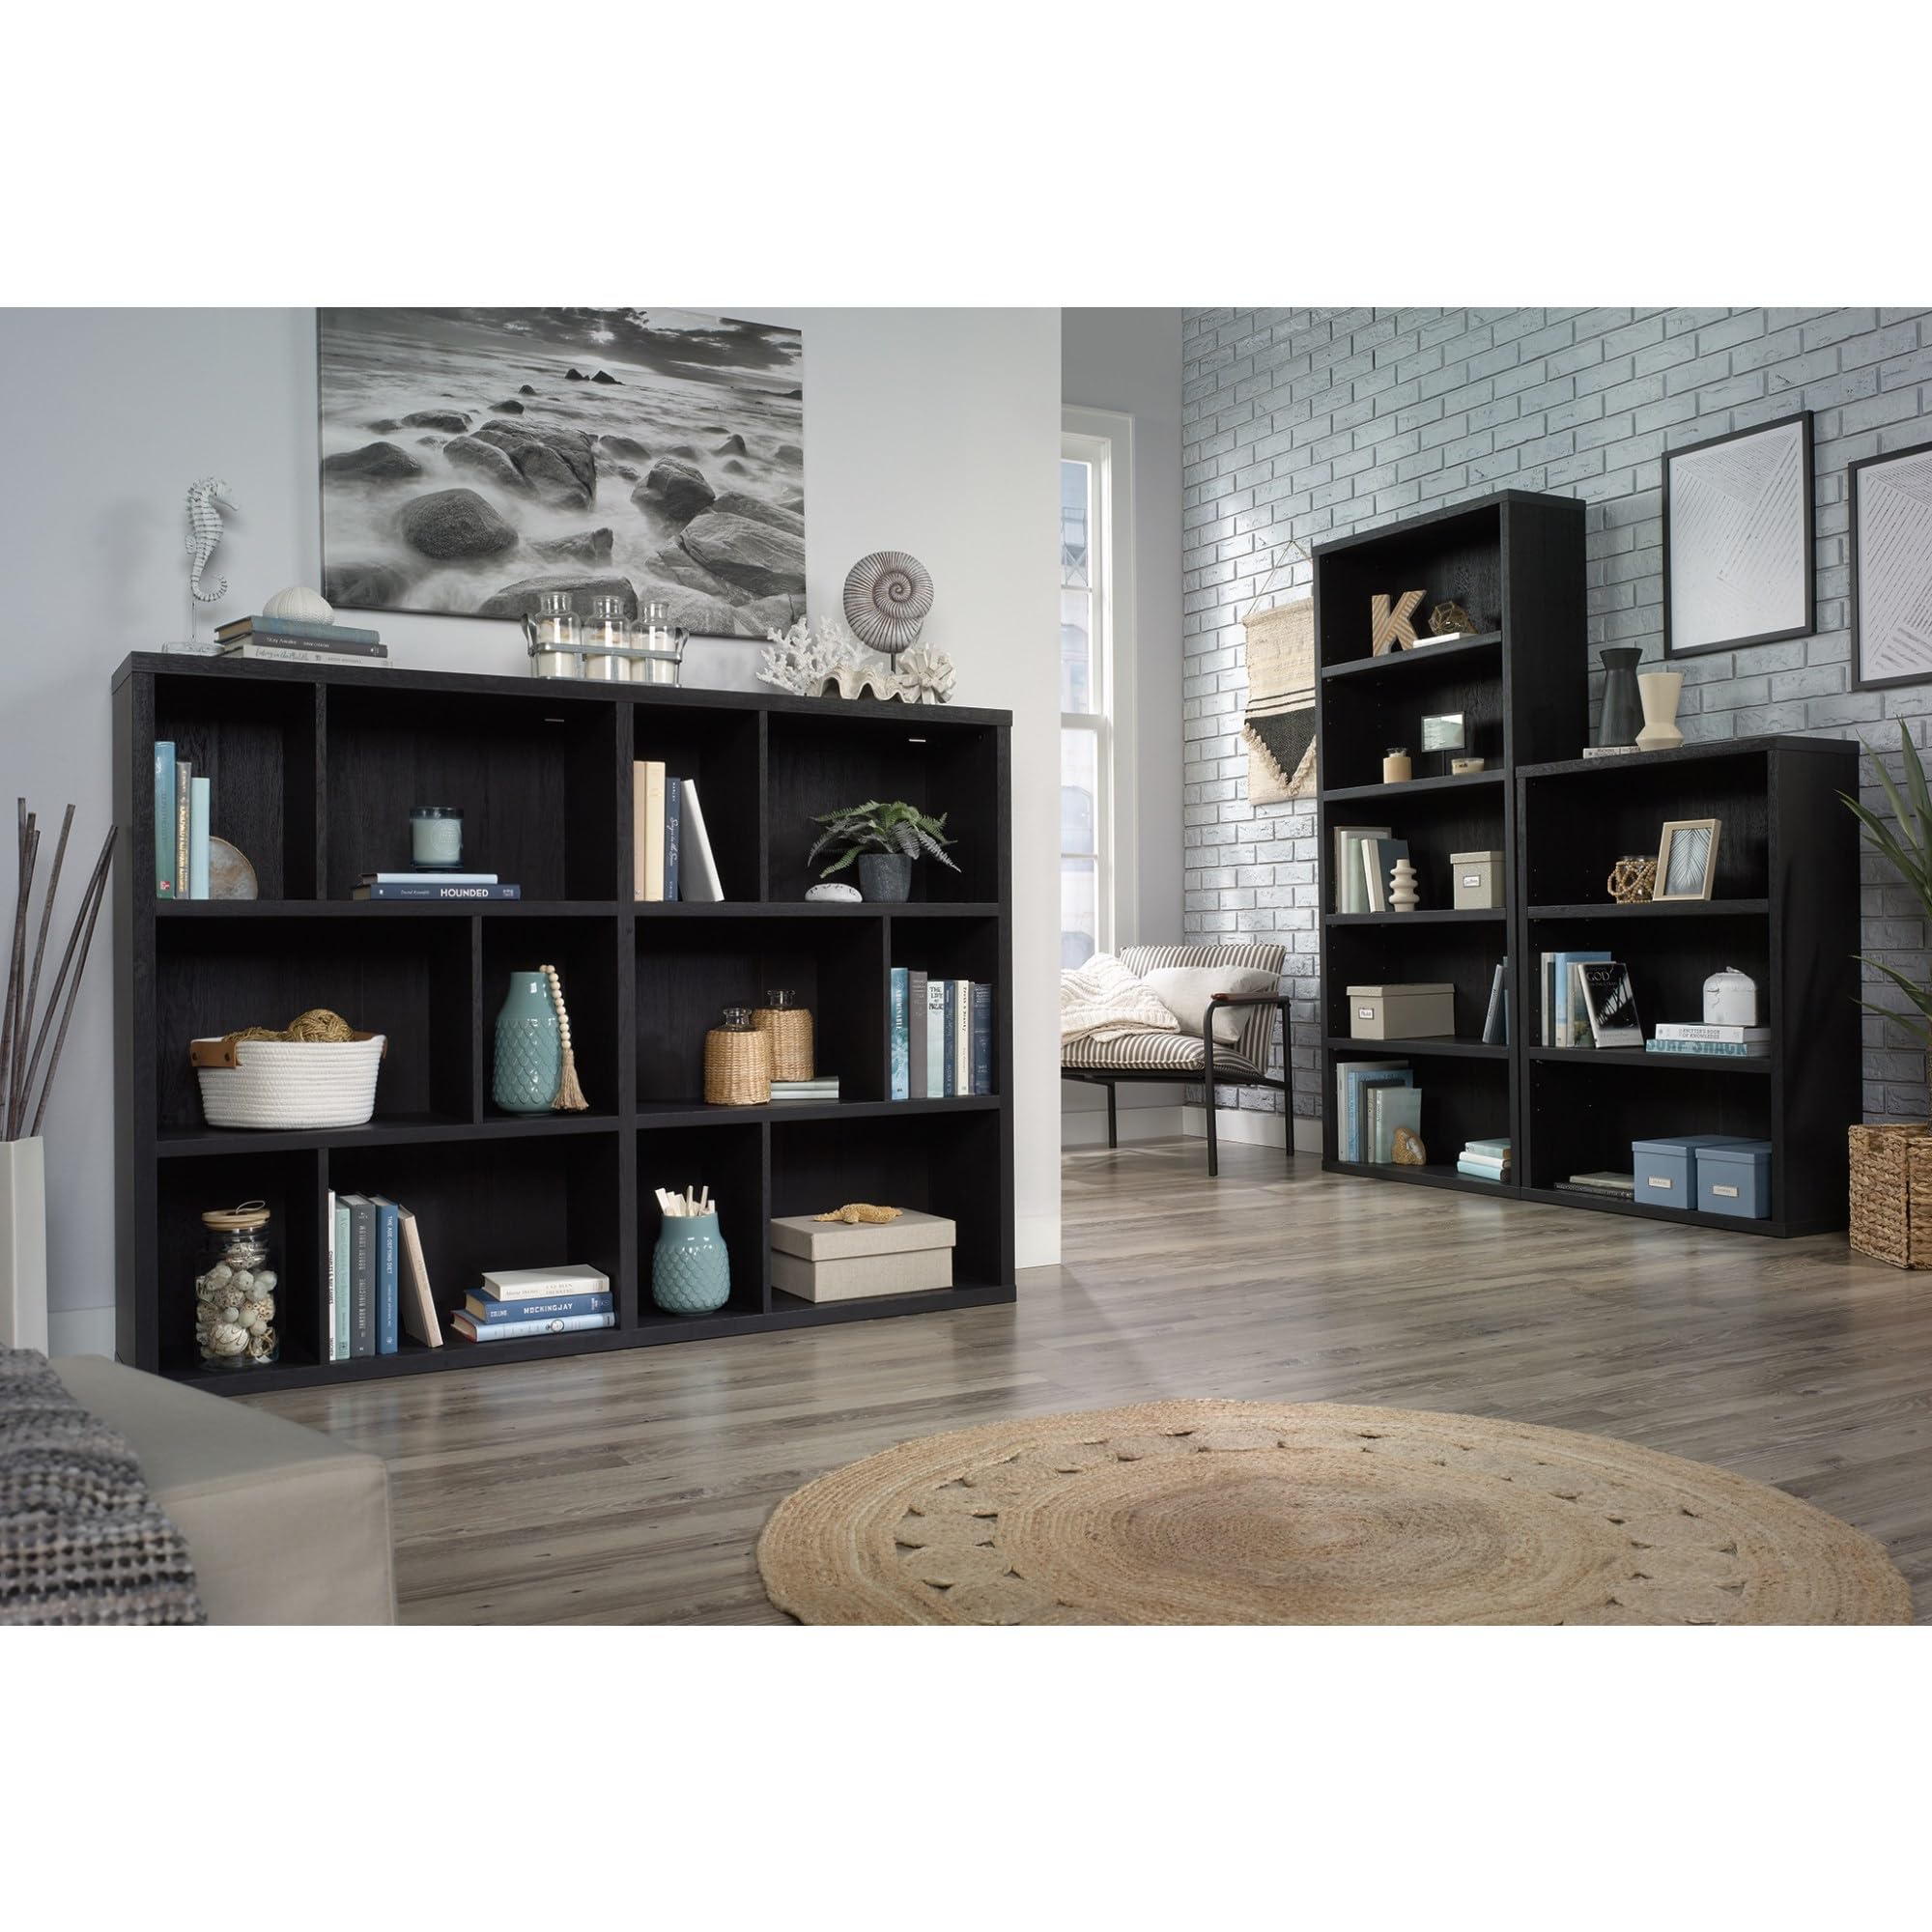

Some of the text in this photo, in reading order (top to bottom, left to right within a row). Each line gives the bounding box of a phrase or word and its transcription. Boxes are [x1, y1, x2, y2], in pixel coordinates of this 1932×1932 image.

[1371, 589, 1427, 658] K
[440, 889, 489, 897] HOUNDED
[1586, 971, 1610, 981] GOD
[1646, 1039, 1747, 1056] SURF SHACK
[524, 1303, 573, 1314] MOCKINGJAY
